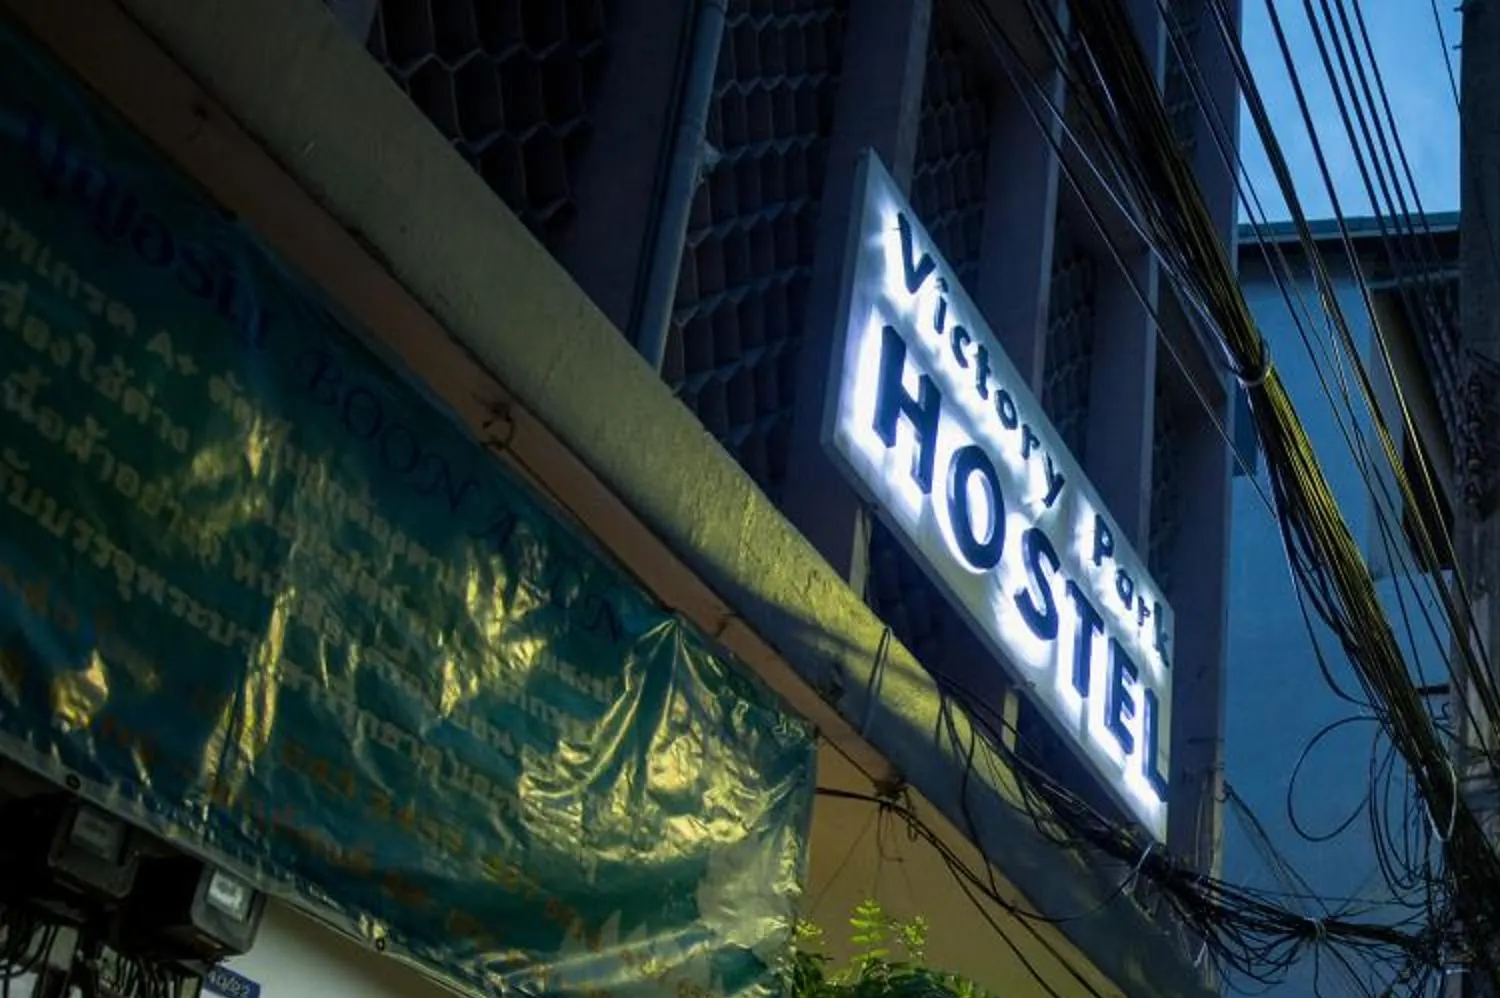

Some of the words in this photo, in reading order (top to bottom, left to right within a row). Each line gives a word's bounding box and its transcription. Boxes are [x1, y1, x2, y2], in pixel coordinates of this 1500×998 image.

[146, 329, 200, 377] A+
[291, 345, 482, 516] BOON
[895, 212, 1065, 508] Victory
[873, 324, 1169, 803] HOSTEL
